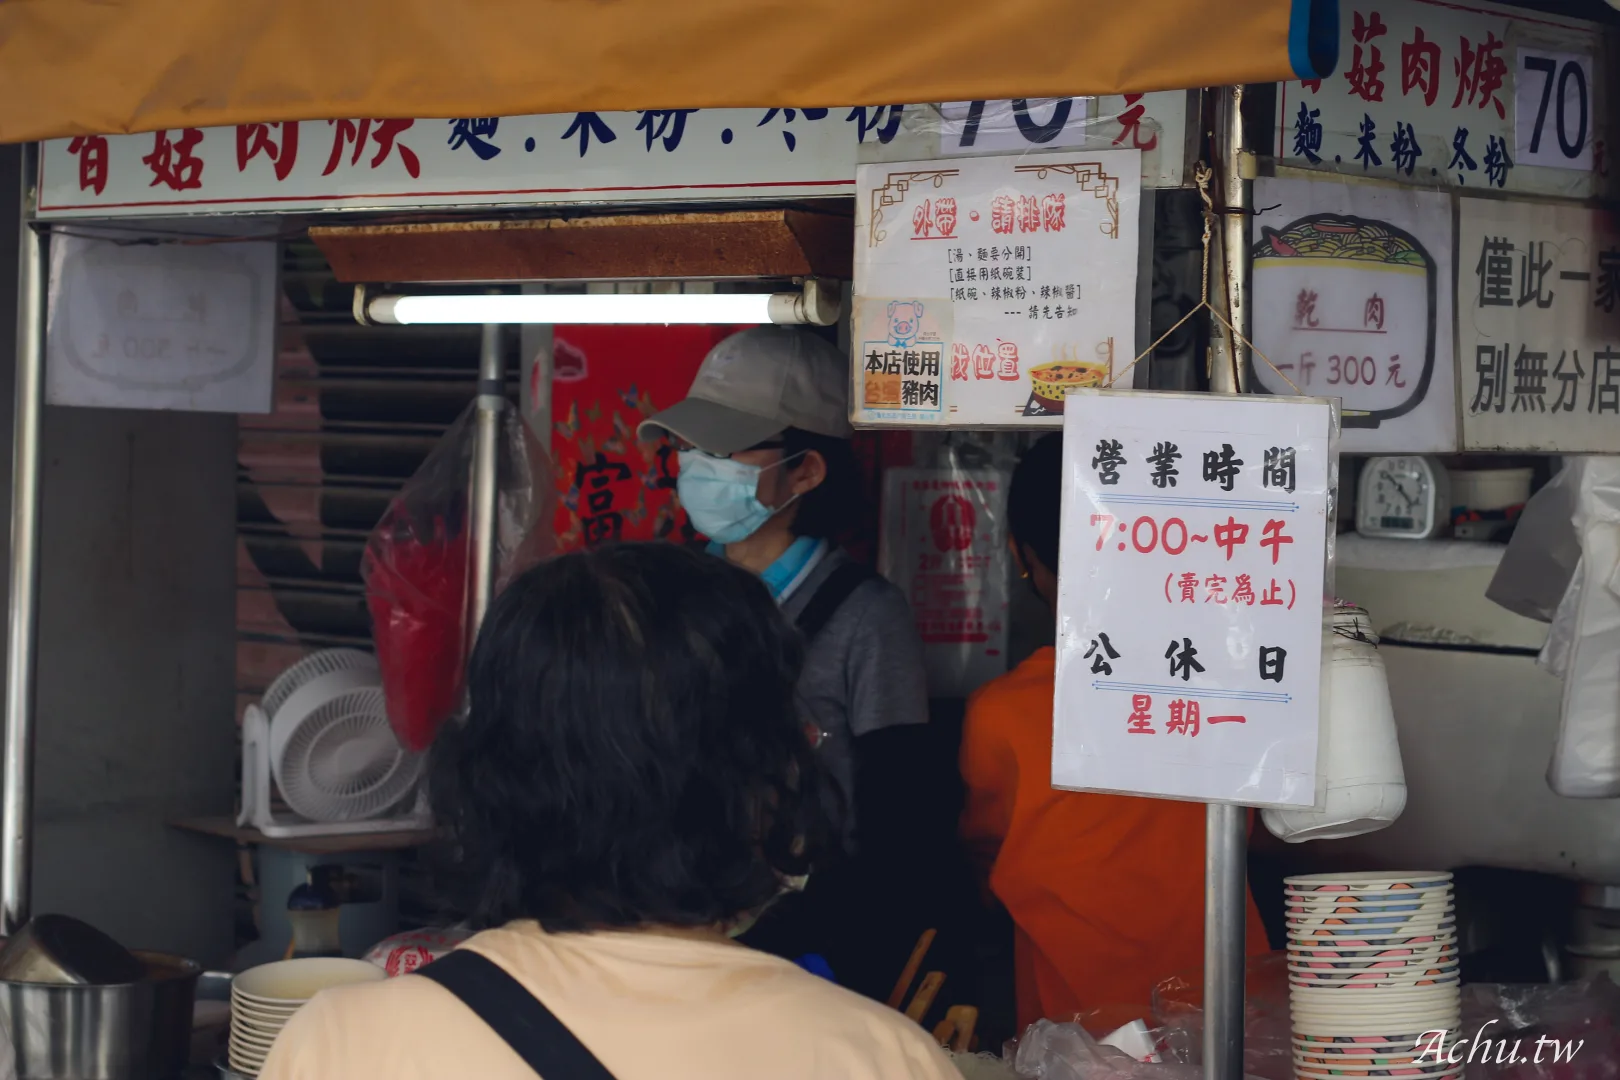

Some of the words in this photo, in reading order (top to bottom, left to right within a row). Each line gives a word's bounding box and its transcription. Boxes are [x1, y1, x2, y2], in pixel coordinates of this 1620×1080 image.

[1301, 11, 1508, 120] 菇肉焿
[1524, 56, 1588, 159] 70
[865, 350, 940, 376] 本店使用
[1470, 343, 1620, 414] 別無分店
[1091, 439, 1297, 494] 營業時間
[1083, 632, 1288, 684] 公休日
[1127, 694, 1247, 738] 星期一
